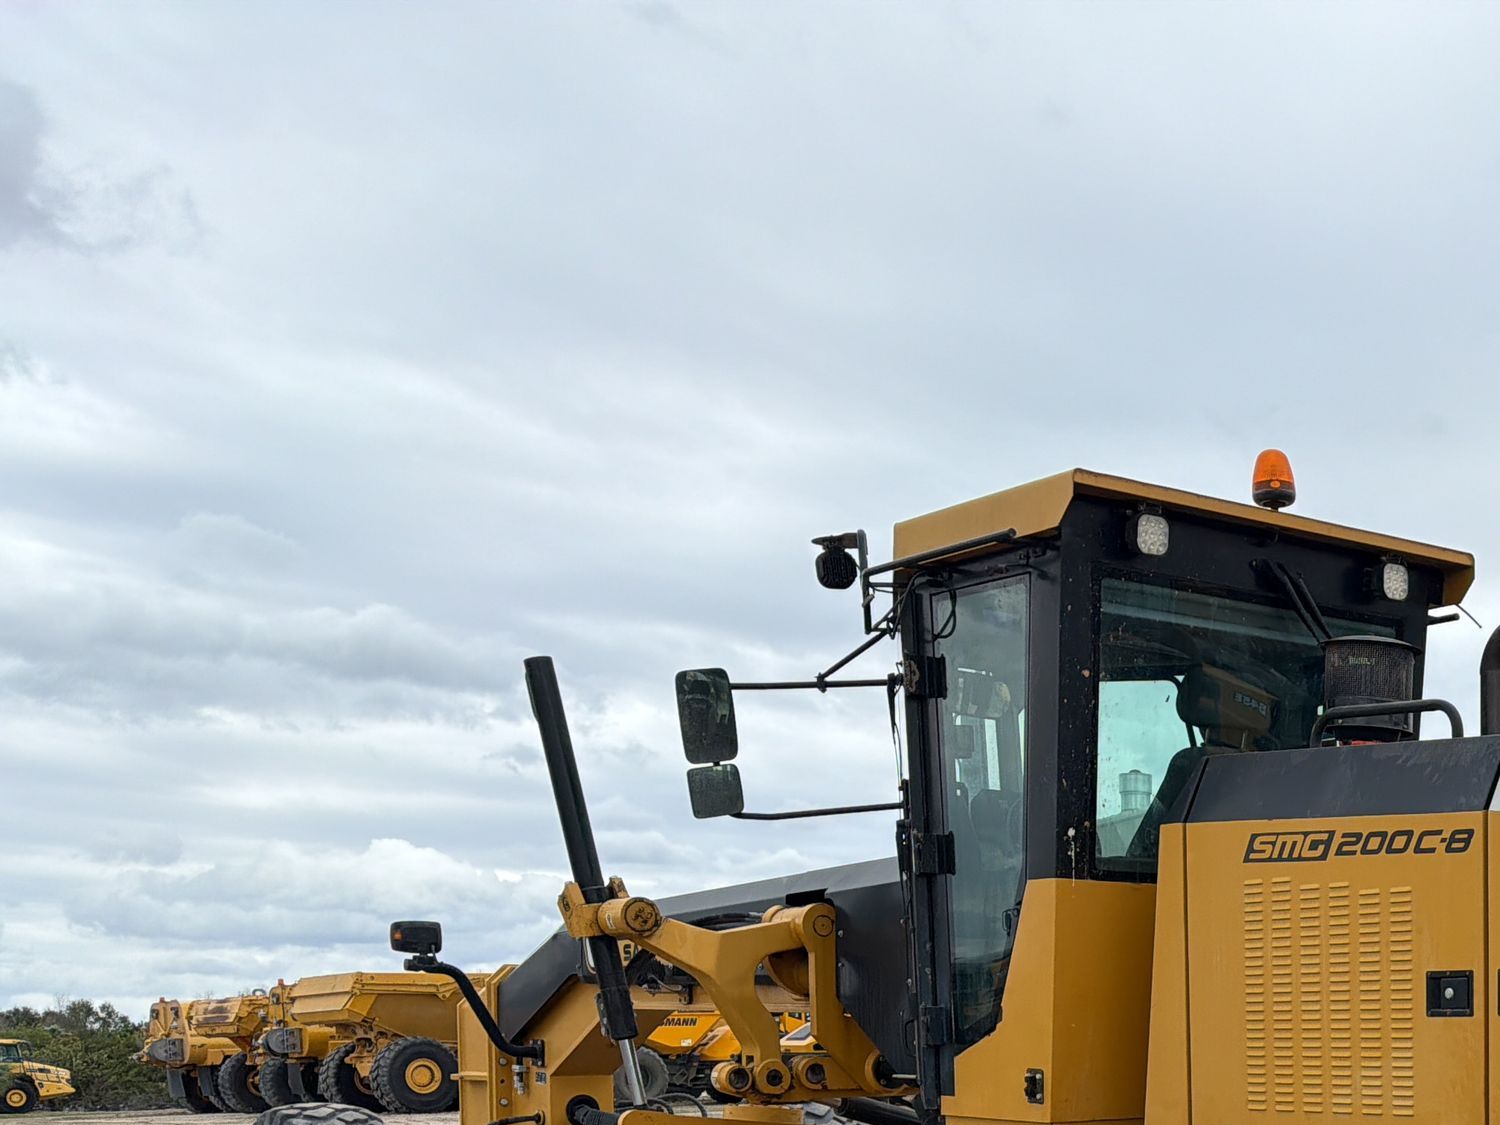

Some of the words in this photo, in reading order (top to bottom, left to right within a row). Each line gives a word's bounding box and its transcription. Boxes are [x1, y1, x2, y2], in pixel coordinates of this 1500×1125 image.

[1246, 832, 1332, 861] SMG
[1334, 829, 1475, 857] 200C-8
[661, 1017, 698, 1027] MANN
